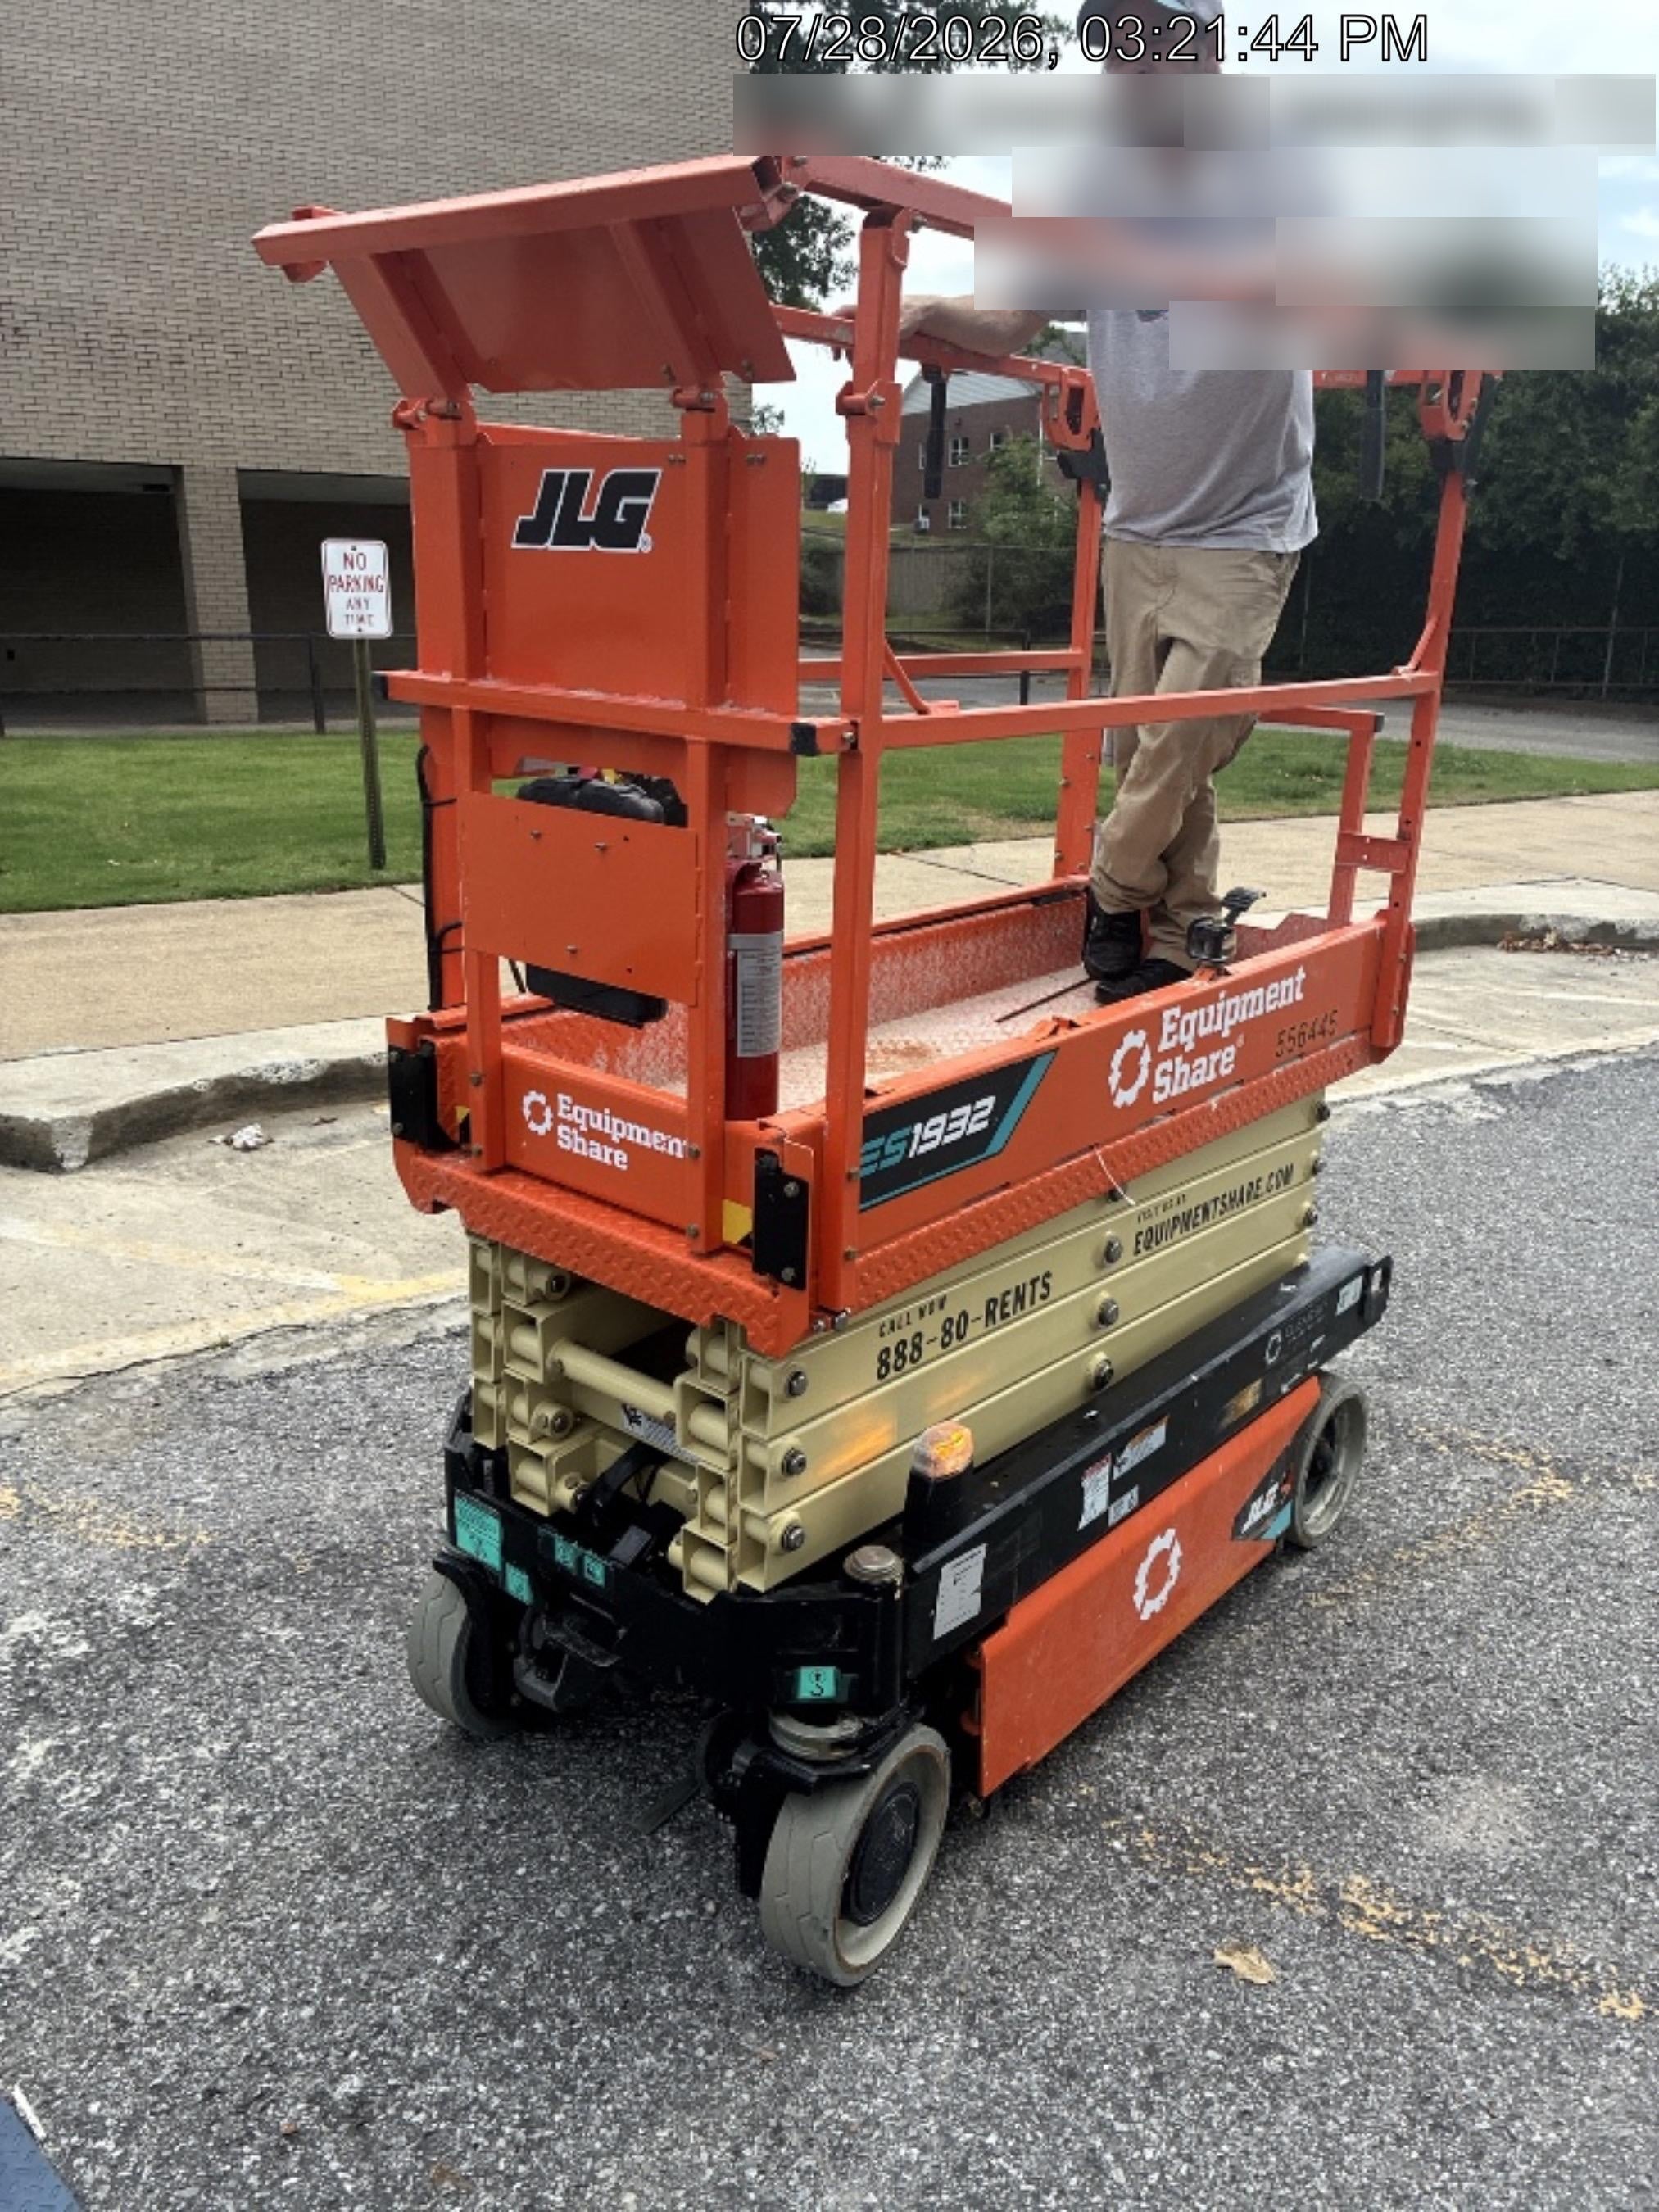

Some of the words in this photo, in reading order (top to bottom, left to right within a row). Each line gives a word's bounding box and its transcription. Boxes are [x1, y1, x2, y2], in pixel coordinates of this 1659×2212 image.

[511, 468, 662, 553] JLG
[329, 575, 384, 592] PARKING
[343, 552, 367, 570] NO
[346, 597, 370, 610] ANY
[1158, 965, 1306, 1052] Equipment
[1275, 1009, 1338, 1058] 556445
[557, 1093, 688, 1158] Equipmen
[557, 1124, 628, 1171] Share
[1133, 1163, 1294, 1256] EQUIPMENTSHARE.COM
[877, 1271, 1053, 1380] 888-80-RENTS
[879, 1311, 912, 1337] CALL
[918, 1294, 947, 1320] NOW
